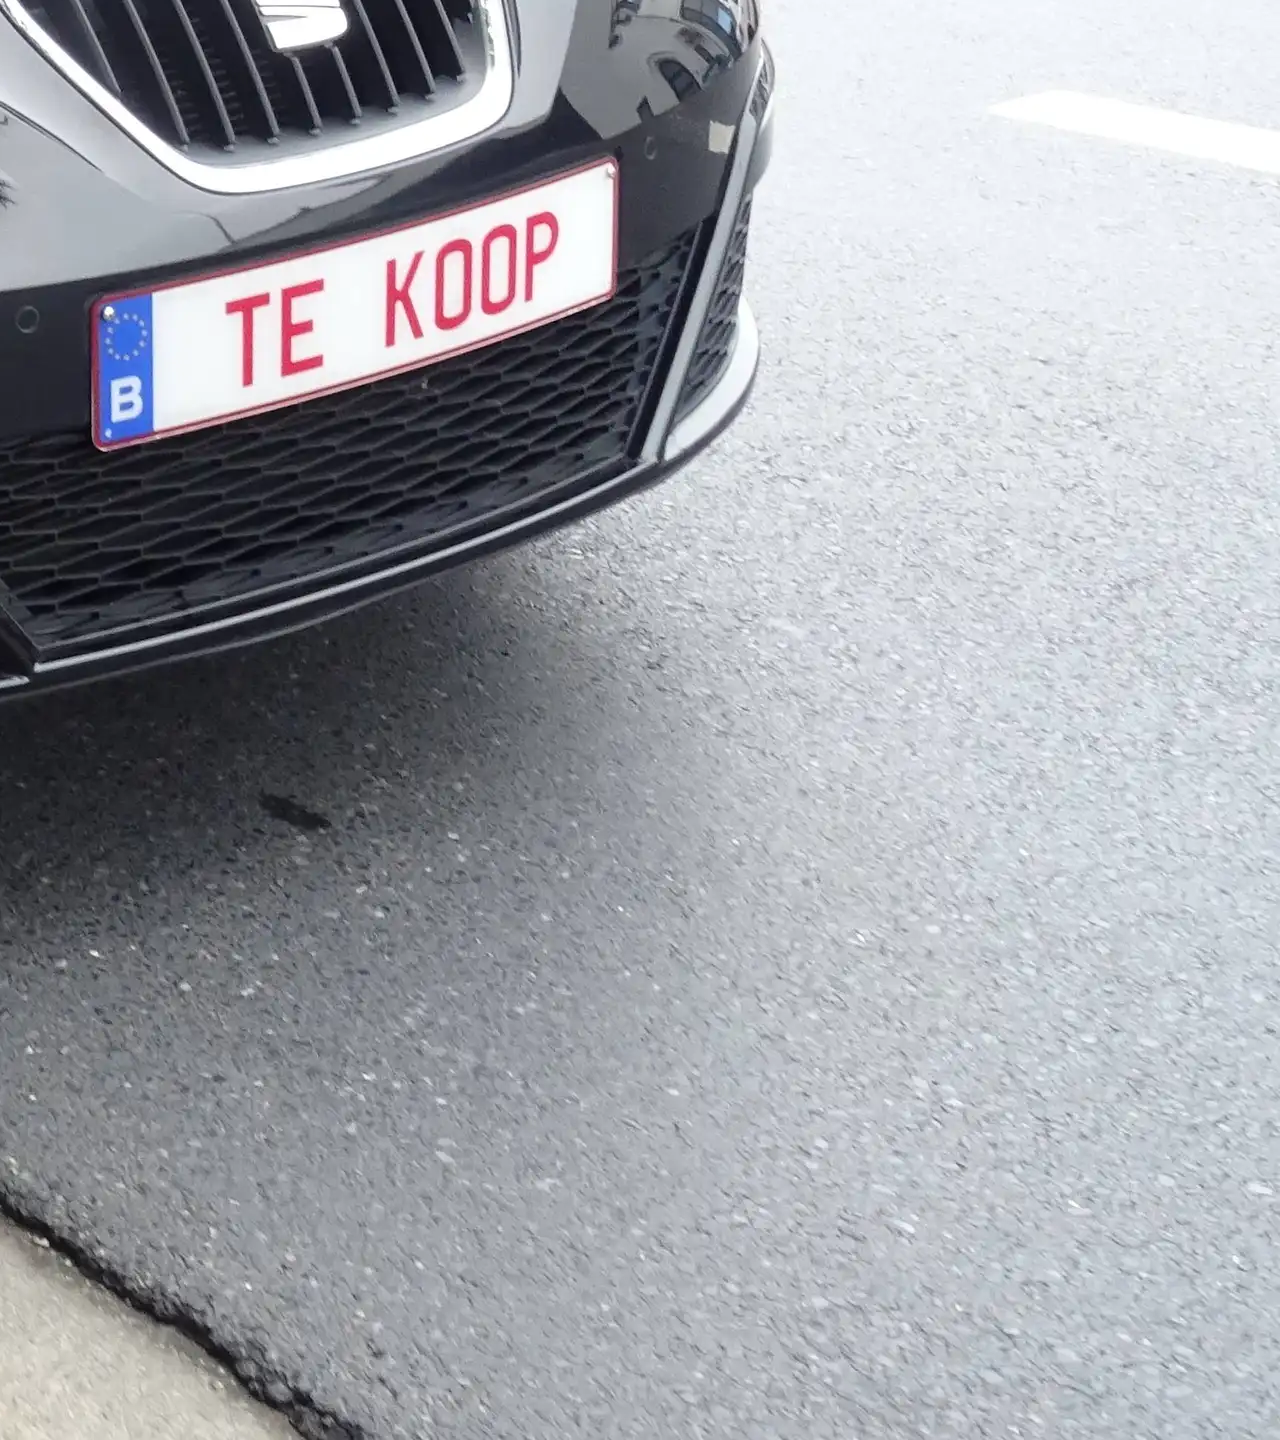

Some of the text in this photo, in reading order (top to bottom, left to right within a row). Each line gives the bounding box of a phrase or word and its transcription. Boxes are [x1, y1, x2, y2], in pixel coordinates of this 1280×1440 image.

[225, 211, 560, 388] TE KOOP
[110, 375, 144, 423] B
